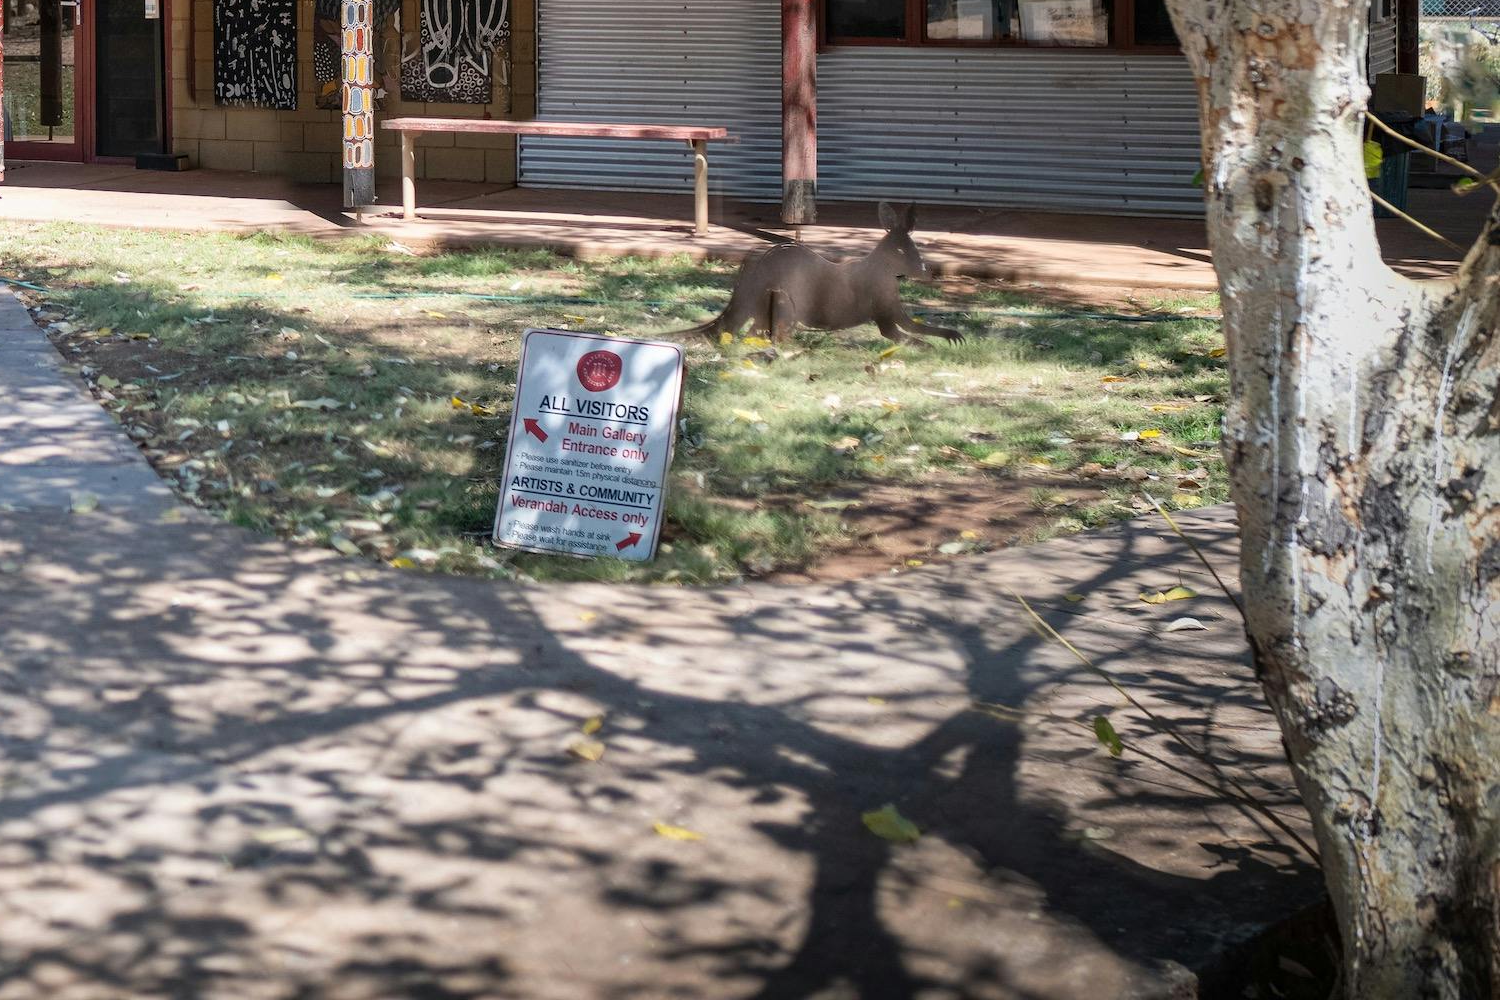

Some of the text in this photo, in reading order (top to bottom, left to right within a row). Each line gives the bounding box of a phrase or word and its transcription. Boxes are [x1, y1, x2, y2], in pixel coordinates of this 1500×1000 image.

[539, 395, 649, 421] ALL VISITORS
[568, 422, 647, 446] Main Gallery
[562, 438, 649, 463] Entrance only
[519, 462, 543, 472] Please
[544, 465, 573, 476] maintain
[591, 471, 620, 483] physical
[521, 452, 632, 476] Please use sanitizer before entry
[511, 476, 655, 505] ARTISTS & COMMUNITY
[511, 494, 649, 527] Verandah Access only
[511, 530, 537, 542] Please
[513, 519, 538, 531] Please
[562, 527, 585, 538] hands
